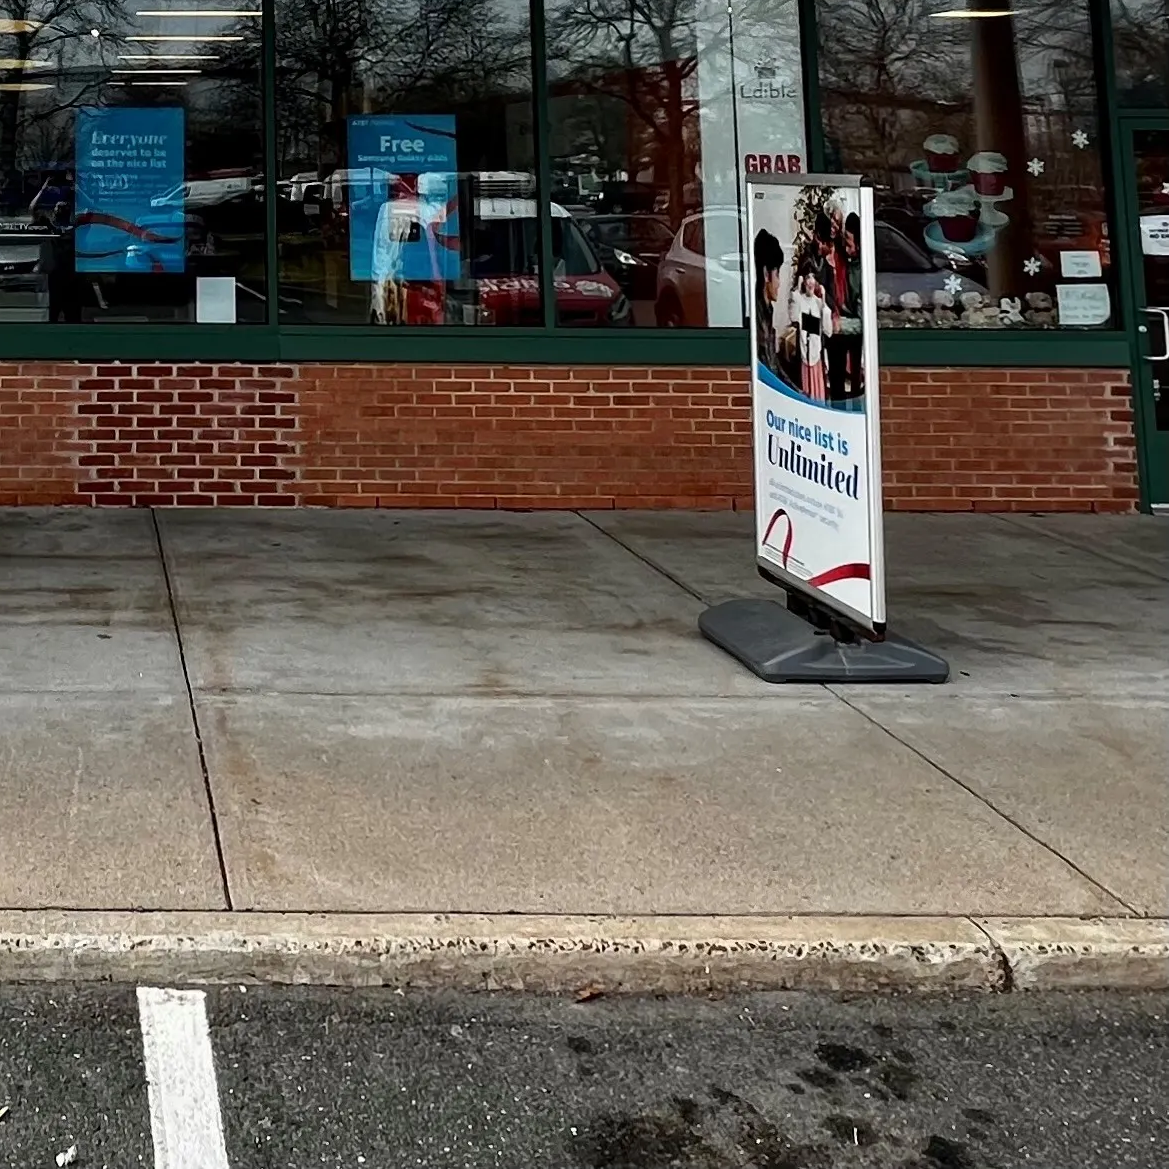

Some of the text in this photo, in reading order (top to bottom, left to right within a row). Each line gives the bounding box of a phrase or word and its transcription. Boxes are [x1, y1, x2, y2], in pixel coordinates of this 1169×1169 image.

[91, 131, 167, 148] Everyone
[380, 136, 425, 152] Free
[91, 148, 167, 157] deserves to be
[91, 159, 167, 168] on the nice list
[744, 153, 801, 174] GRAB
[766, 409, 849, 456] Our nice list is
[767, 432, 860, 501] Unlimited
